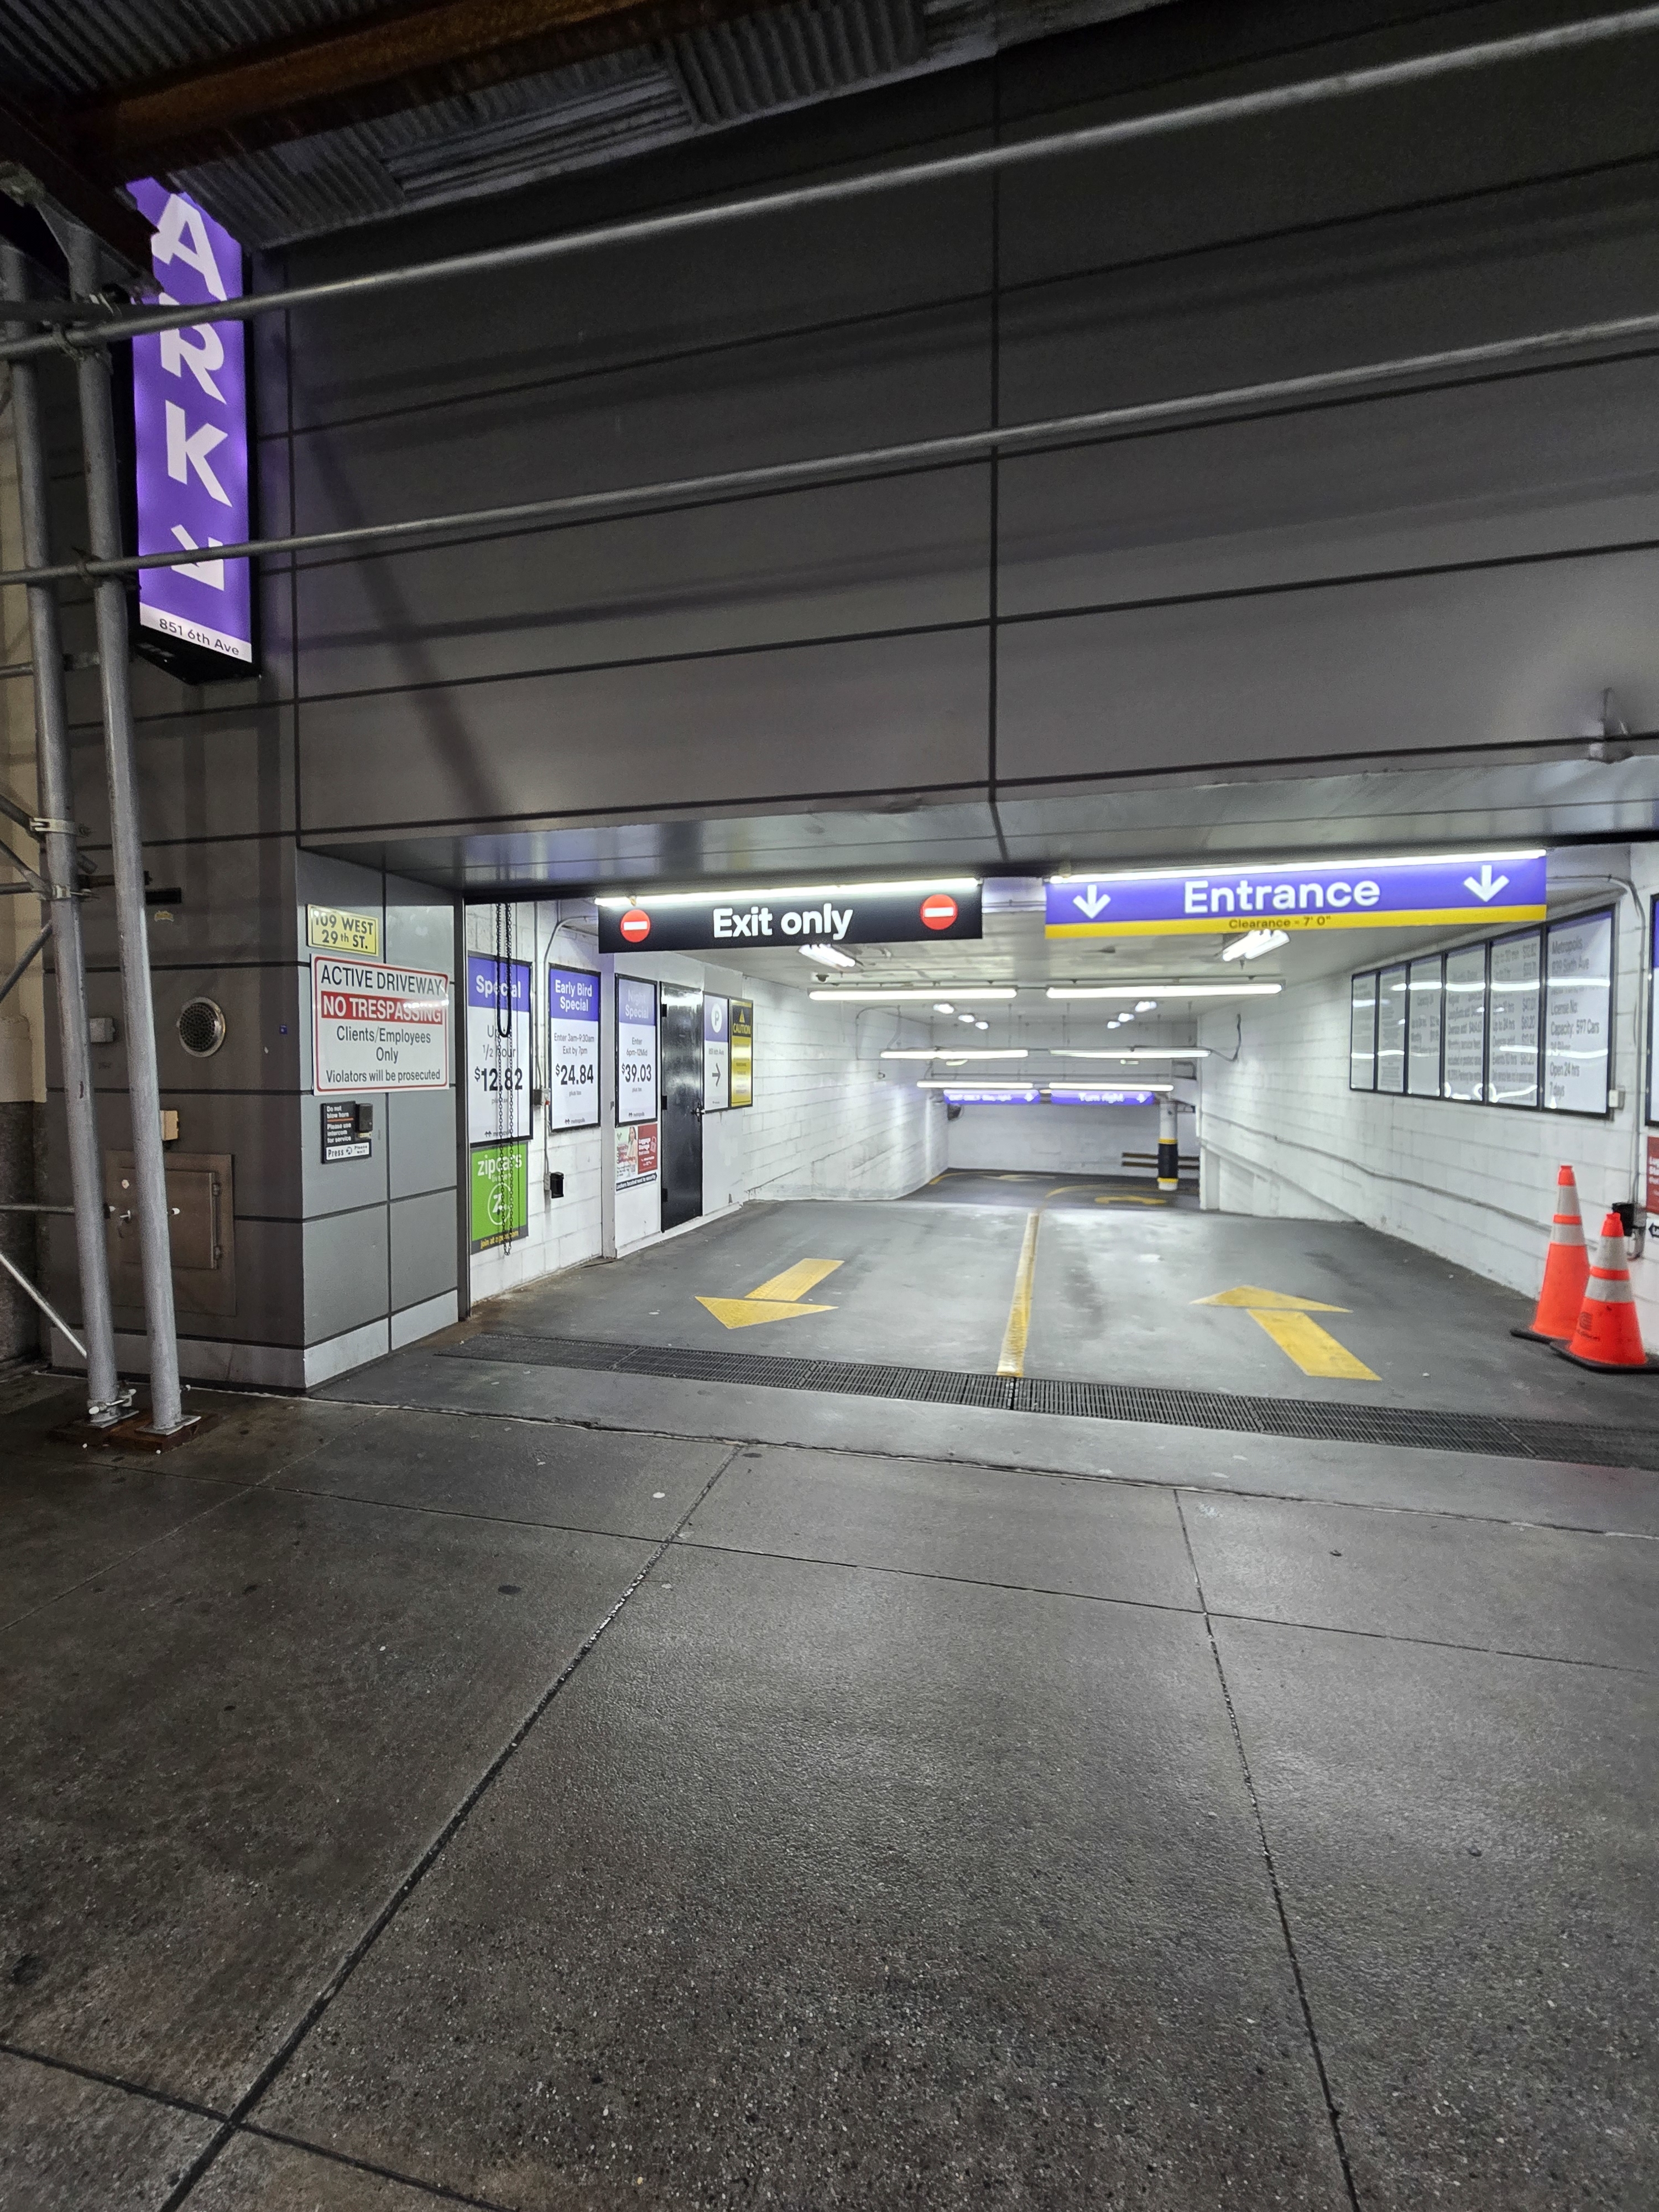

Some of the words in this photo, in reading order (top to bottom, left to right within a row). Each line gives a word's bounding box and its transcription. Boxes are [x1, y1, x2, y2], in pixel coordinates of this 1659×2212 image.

[152, 194, 233, 508] ARK
[159, 618, 183, 635] 851
[187, 629, 210, 646] 6th
[214, 639, 239, 655] Ave
[1183, 880, 1380, 914] Entrance
[315, 913, 337, 928] 109
[341, 916, 373, 935] WEST
[713, 907, 773, 938] Exit
[780, 902, 853, 940] only
[1229, 918, 1291, 928] Clearance
[352, 934, 368, 949] ST.
[321, 964, 373, 988] ACTIVE
[377, 972, 442, 995] DRIVEWAY
[476, 975, 521, 998] Specal
[555, 979, 575, 997] Early
[577, 982, 592, 997] Bird
[560, 996, 588, 1013] Special
[628, 989, 646, 1006] Night
[324, 995, 346, 1016] NO
[349, 998, 441, 1022] TRESPASSING
[625, 1004, 649, 1020] Special
[733, 1022, 751, 1034] CAUTION
[1576, 1019, 1587, 1034] 597
[1587, 1018, 1599, 1034] Cars
[336, 1025, 431, 1045] Clients/Employees
[554, 1033, 567, 1041] Enter
[632, 1037, 643, 1045] Enter
[376, 1047, 398, 1064] Only
[563, 1046, 571, 1054] Exit
[572, 1046, 578, 1056] by
[326, 1070, 367, 1083] Violators
[369, 1069, 383, 1081] will
[385, 1069, 396, 1081] be
[398, 1068, 440, 1083] prosecuted
[555, 1063, 593, 1085] $24.84
[622, 1063, 651, 1082] $39.03
[1550, 1062, 1564, 1078] Open
[1564, 1061, 1571, 1077] 24
[1572, 1062, 1580, 1077] hrs
[474, 1066, 523, 1092] $12.82
[328, 1149, 344, 1157] Press
